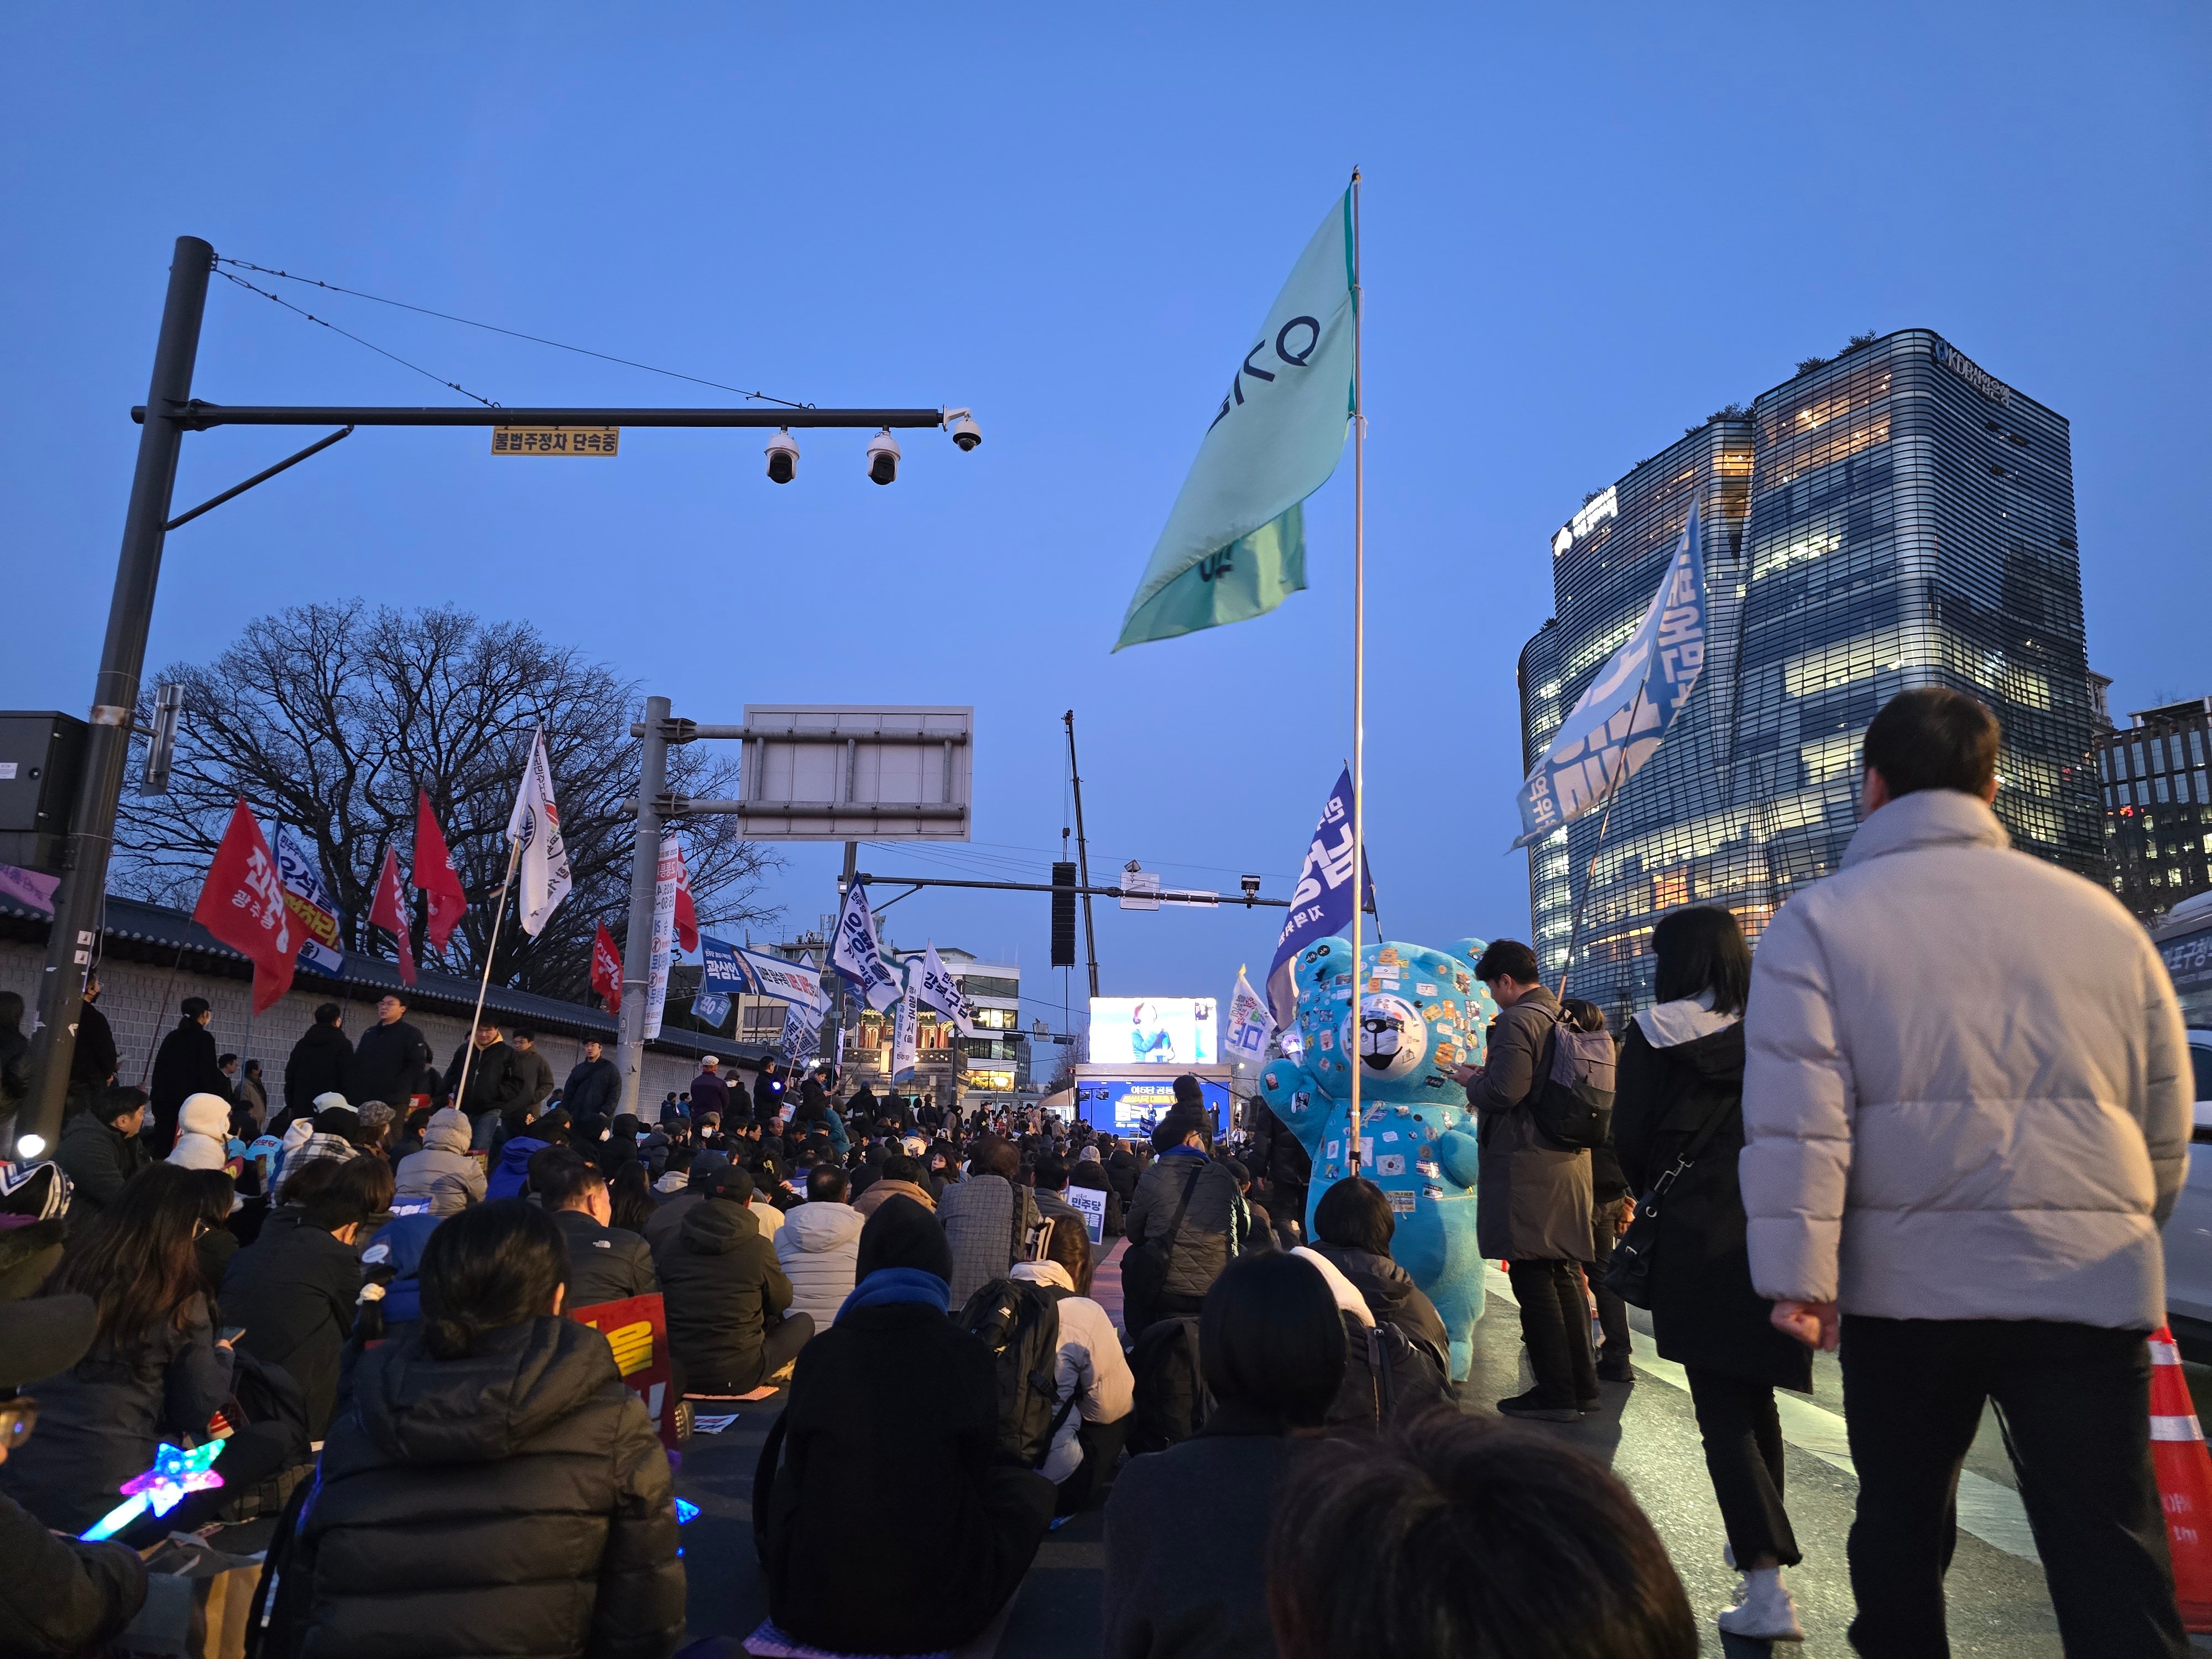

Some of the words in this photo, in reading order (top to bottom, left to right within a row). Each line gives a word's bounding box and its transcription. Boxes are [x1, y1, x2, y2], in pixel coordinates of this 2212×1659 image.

[495, 433, 567, 451] 불법주정차
[573, 433, 616, 451] 단속중
[2163, 934, 2212, 970] 마포구청
[706, 960, 742, 980] 곽상언
[1071, 1197, 1102, 1211] 민주당
